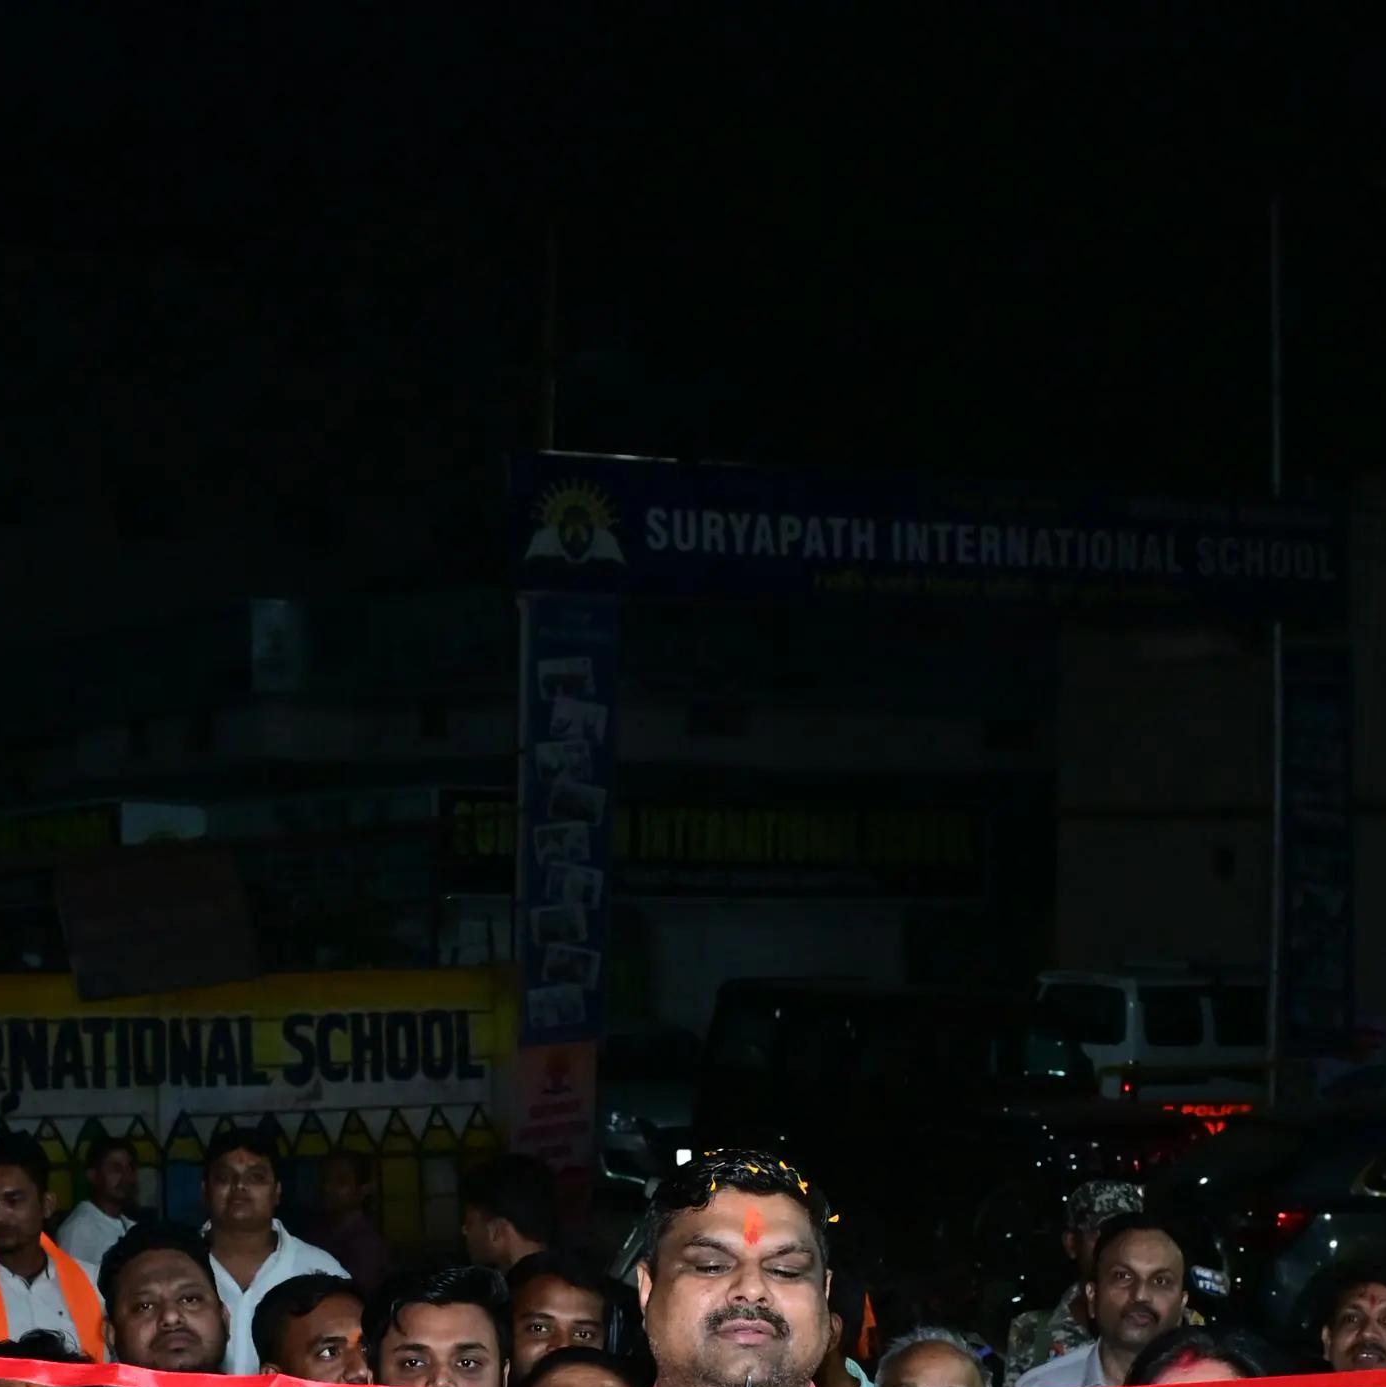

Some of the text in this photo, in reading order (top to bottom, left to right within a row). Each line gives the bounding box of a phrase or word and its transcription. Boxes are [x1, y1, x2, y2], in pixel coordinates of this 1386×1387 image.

[644, 507, 1338, 583] SURYAPATH INTERNATIONAL SCHOOL
[282, 1010, 486, 1087] SCHOOL
